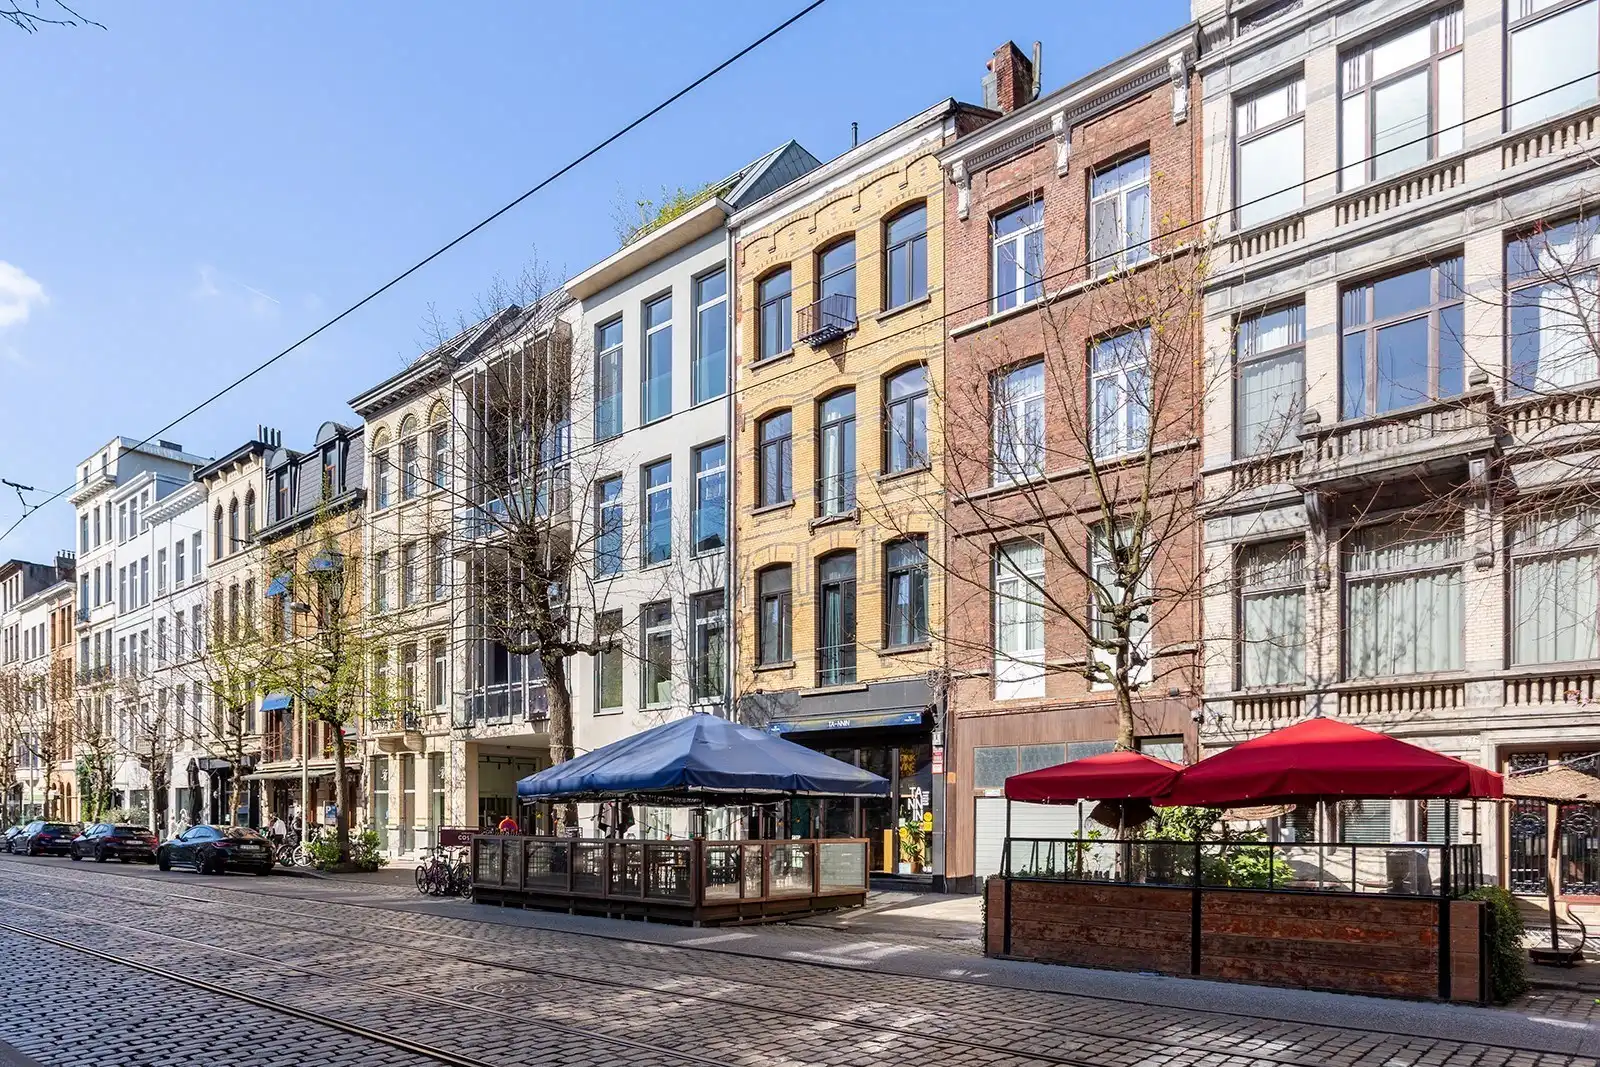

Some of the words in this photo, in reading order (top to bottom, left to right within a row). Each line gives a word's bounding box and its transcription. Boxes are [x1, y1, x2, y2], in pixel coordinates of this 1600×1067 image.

[909, 786, 922, 799] TA
[326, 806, 331, 814] P
[908, 798, 923, 810] NN
[913, 809, 923, 821] IN
